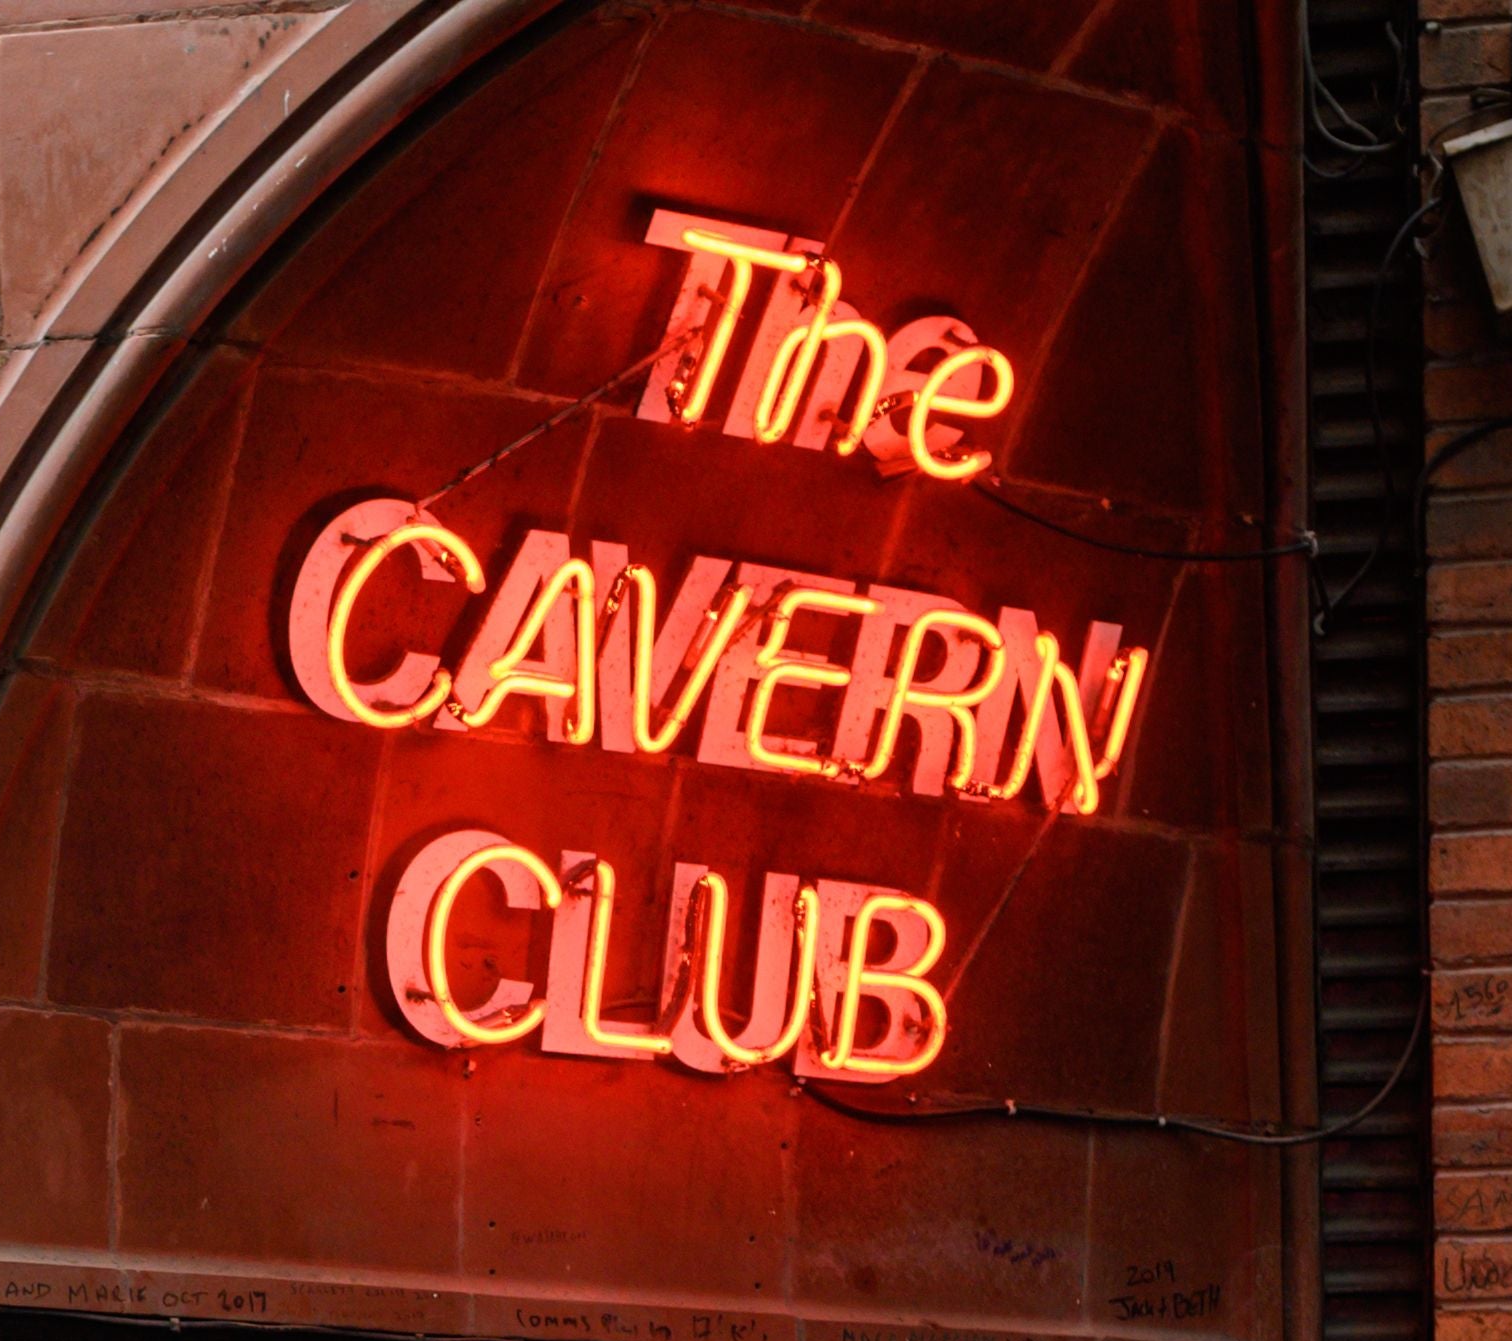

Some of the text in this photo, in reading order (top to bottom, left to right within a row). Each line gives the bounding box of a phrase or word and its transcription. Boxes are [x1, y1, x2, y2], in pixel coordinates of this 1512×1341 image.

[636, 208, 1014, 480] The
[288, 498, 1149, 816] CAVERN
[385, 829, 947, 1082] CLUB
